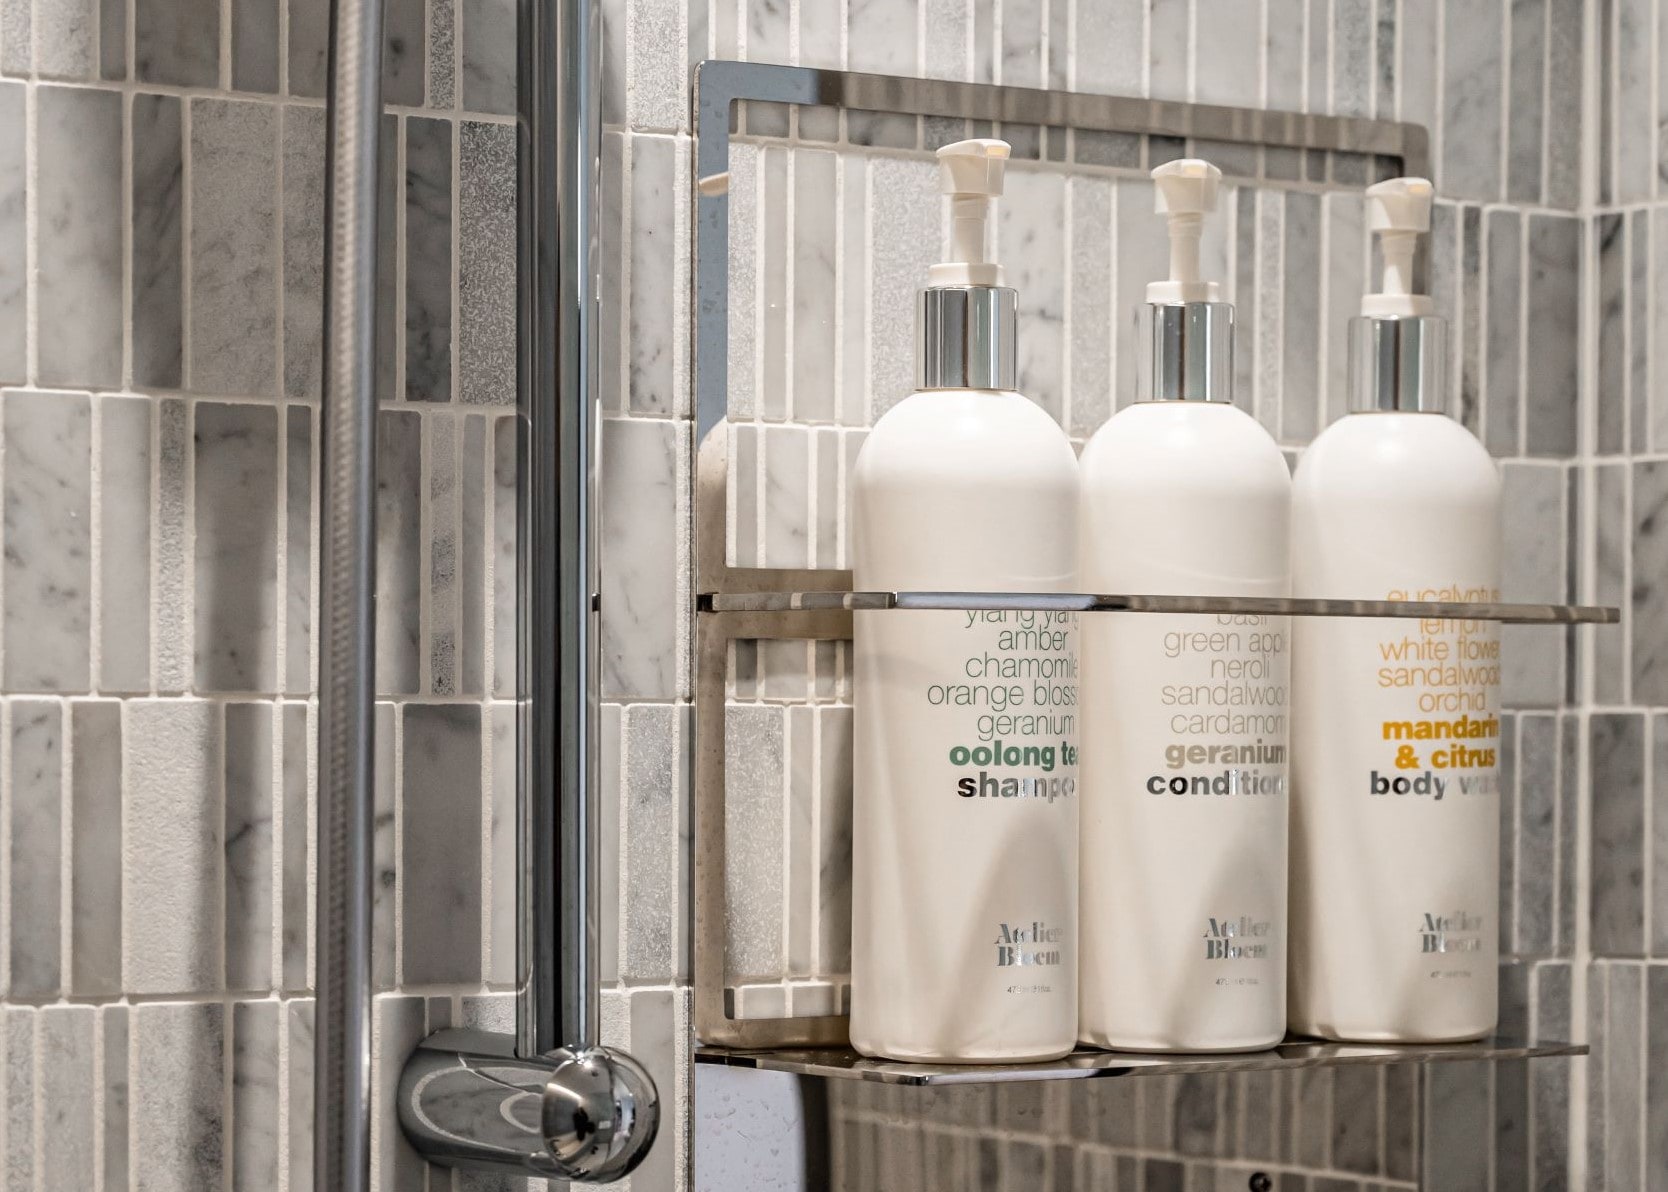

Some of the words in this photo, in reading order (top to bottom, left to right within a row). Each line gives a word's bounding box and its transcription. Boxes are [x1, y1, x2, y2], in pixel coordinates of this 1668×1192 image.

[998, 624, 1068, 651] amber
[1164, 632, 1240, 658] green
[1249, 630, 1286, 657] app
[1379, 636, 1449, 661] white
[1457, 636, 1500, 660] flowe
[1211, 654, 1270, 679] neroli
[927, 685, 1024, 712] orange
[1033, 679, 1079, 706] bloss
[1161, 680, 1287, 706] sandalwoo
[1419, 687, 1486, 713] orchid
[977, 709, 1075, 742] geranium
[949, 740, 1055, 772] oolong
[1395, 745, 1420, 769] &
[1431, 743, 1496, 769] citrus
[1370, 770, 1446, 801] body
